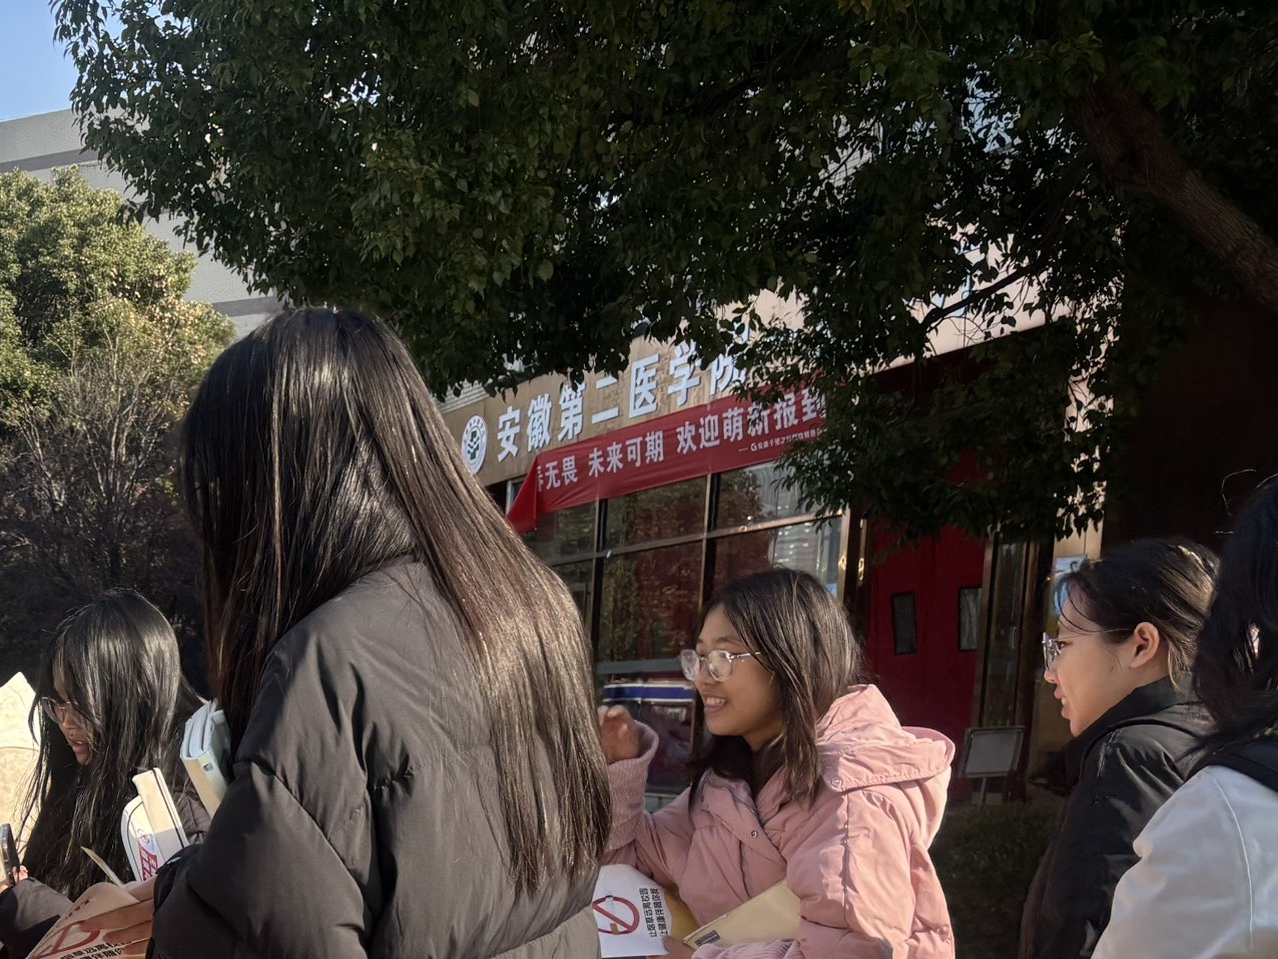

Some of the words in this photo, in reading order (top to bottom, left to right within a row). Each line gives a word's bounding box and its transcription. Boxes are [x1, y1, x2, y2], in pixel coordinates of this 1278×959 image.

[588, 430, 665, 478] 未来可期
[676, 388, 827, 455] 欢迎萌新报到
